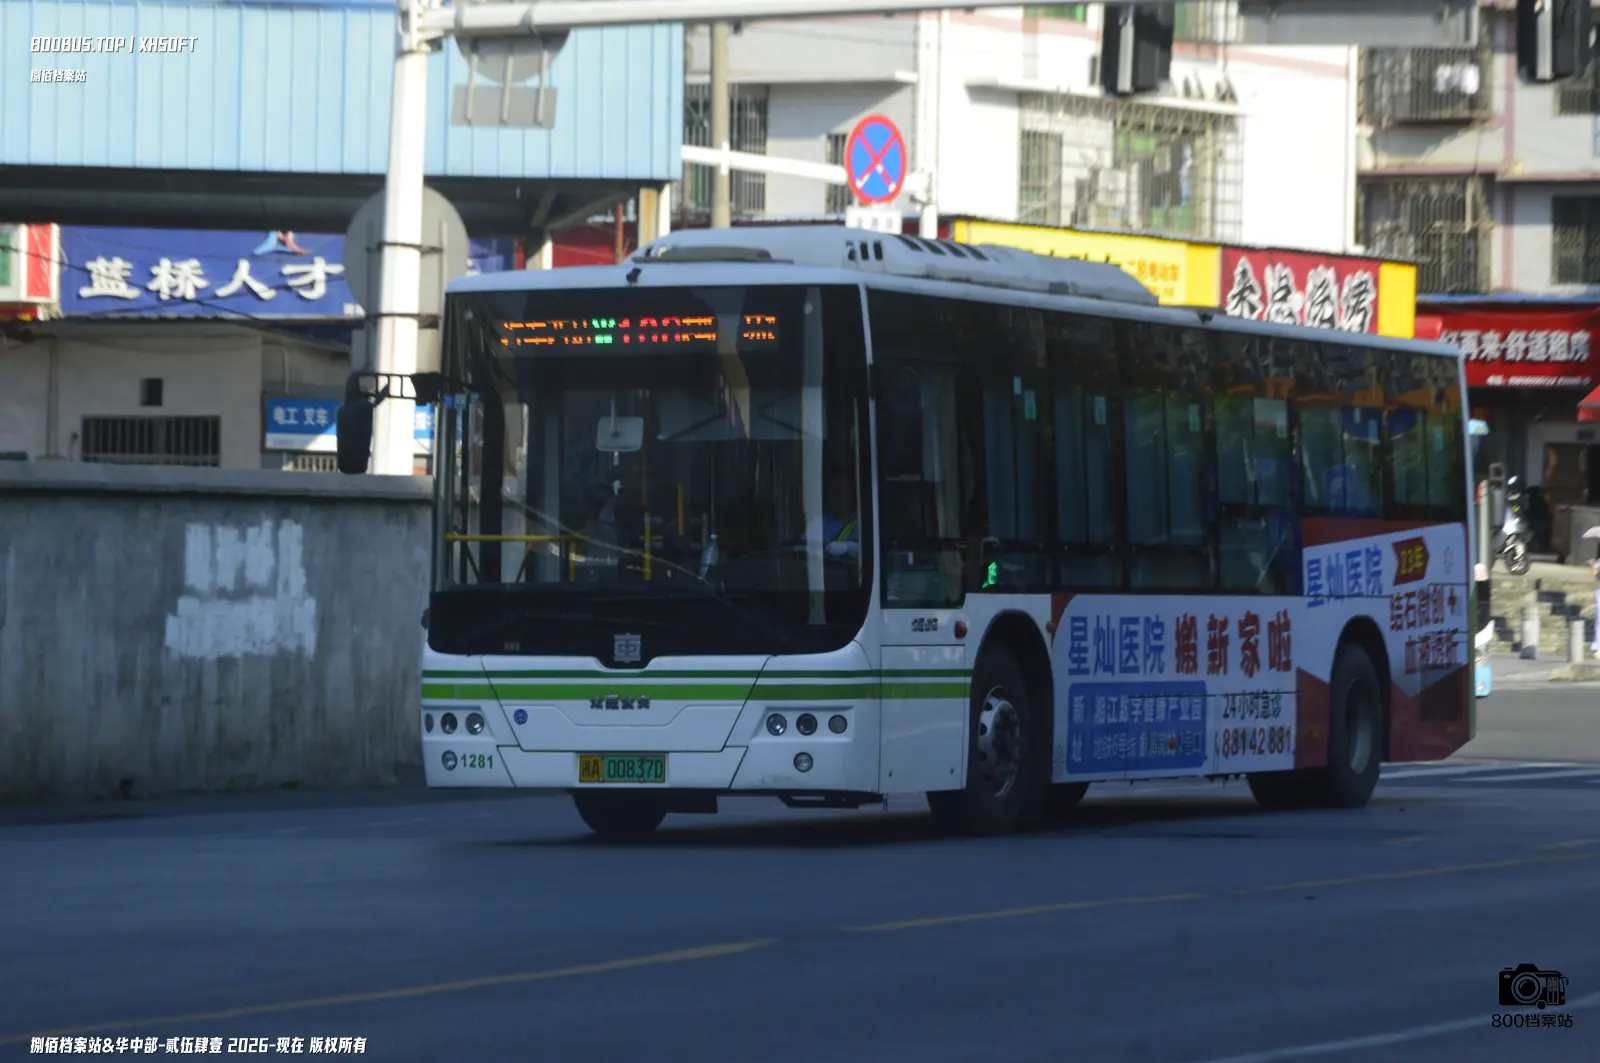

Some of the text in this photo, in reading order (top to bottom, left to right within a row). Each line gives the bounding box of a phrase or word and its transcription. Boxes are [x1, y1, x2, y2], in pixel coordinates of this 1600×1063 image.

[80, 256, 345, 301] 蓝桥人才
[1067, 608, 1292, 679] 星灿医院 搬新家啦
[460, 753, 493, 770] 1281
